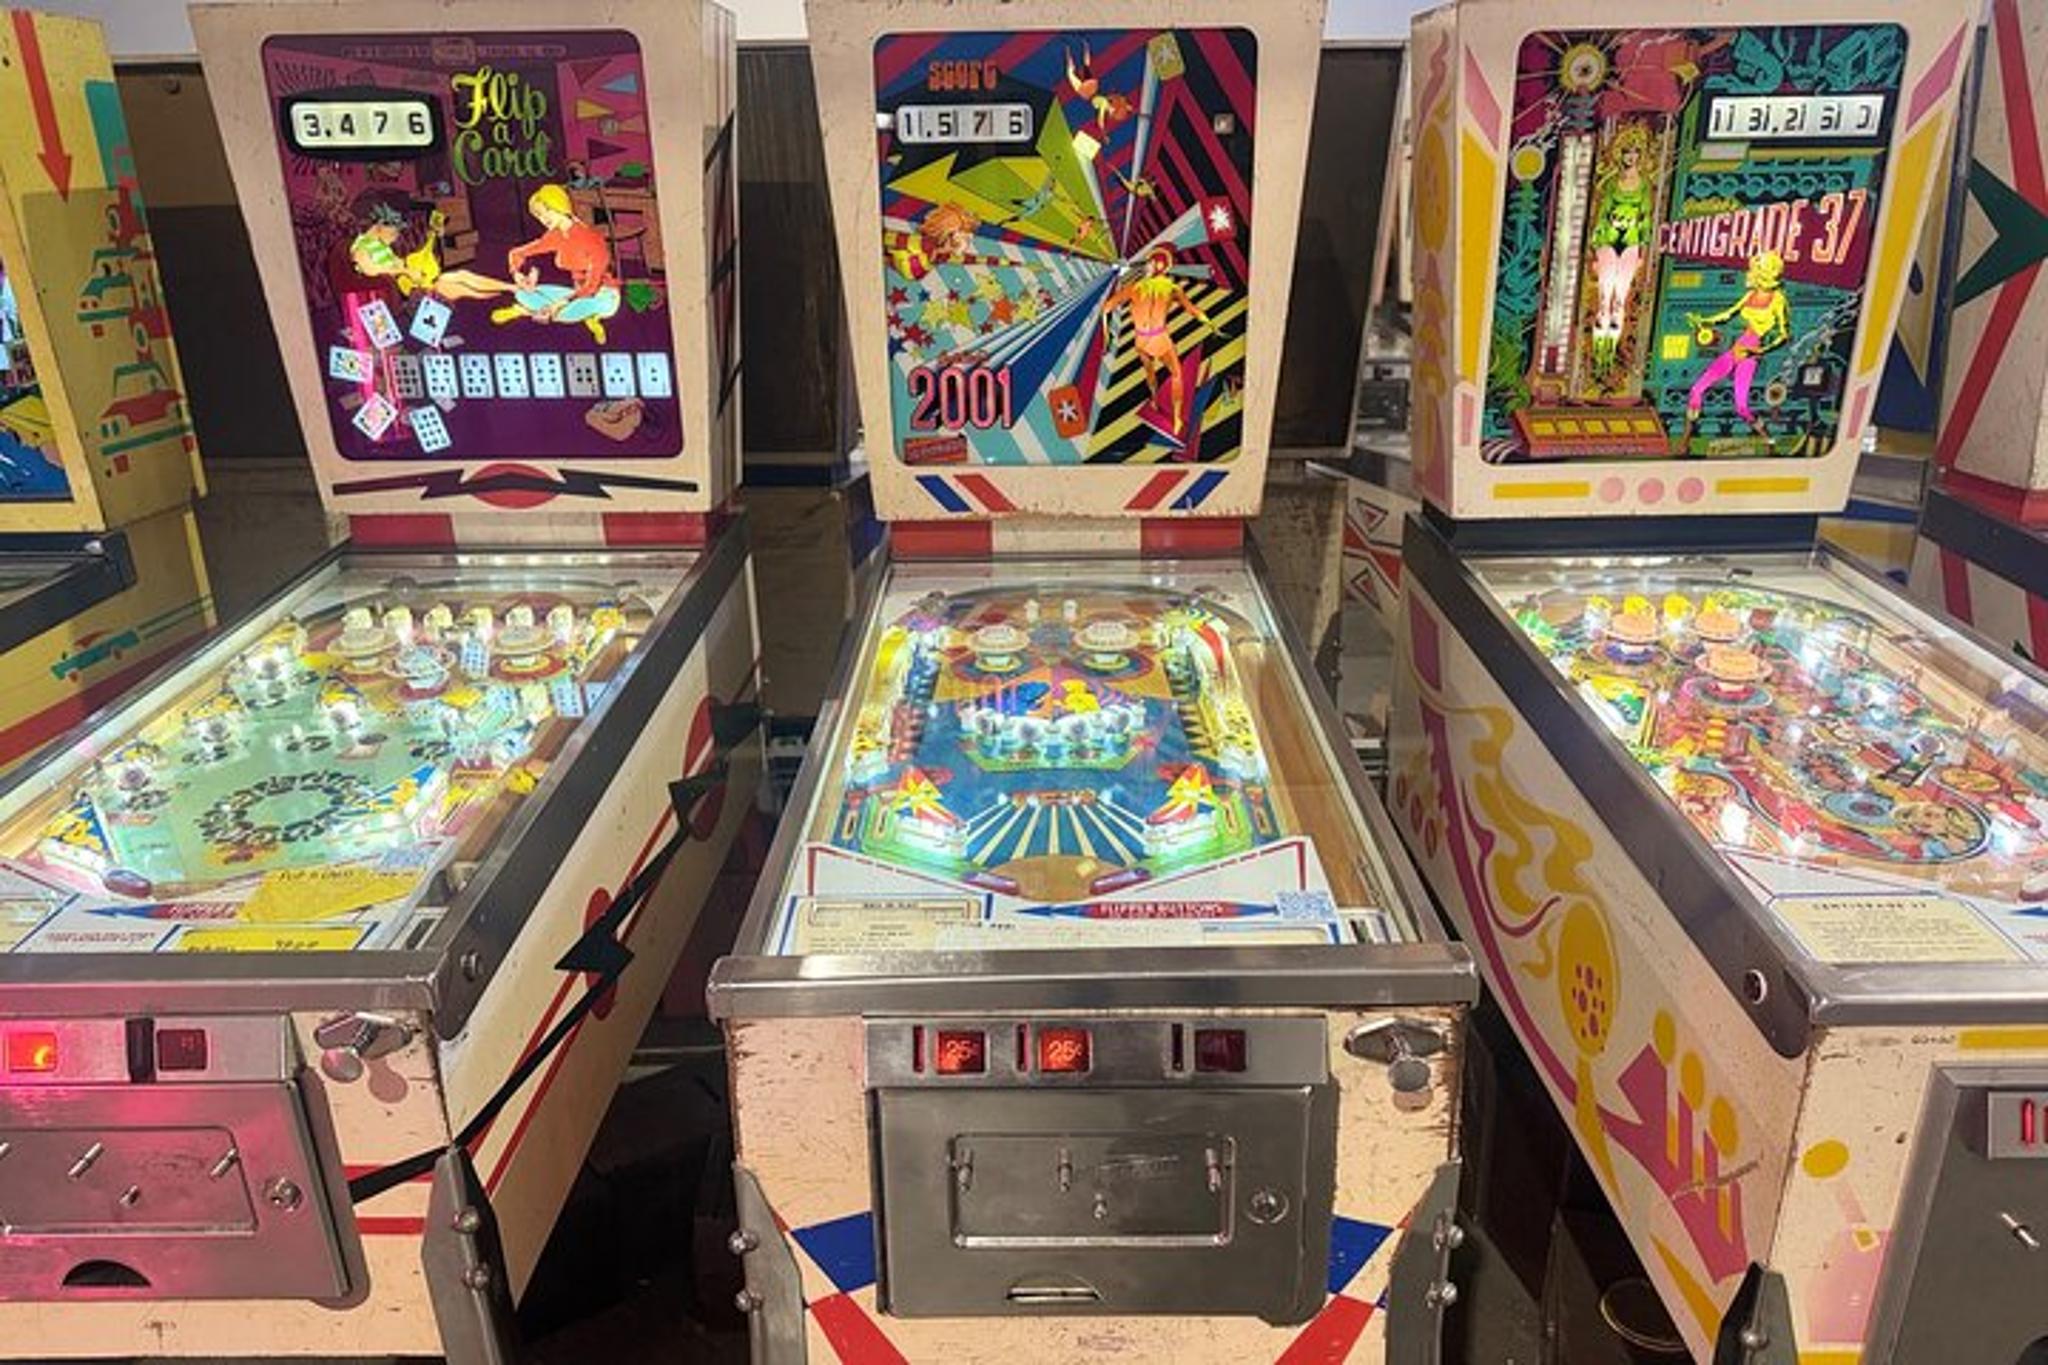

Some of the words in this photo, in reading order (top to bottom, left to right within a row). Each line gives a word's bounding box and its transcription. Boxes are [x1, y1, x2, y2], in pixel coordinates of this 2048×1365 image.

[452, 65, 547, 140] Flip
[494, 122, 513, 145] a
[453, 130, 558, 185] Card
[1659, 199, 1809, 262] CENTIGRADE
[1811, 188, 1867, 265] 37
[908, 365, 1012, 431] 2001
